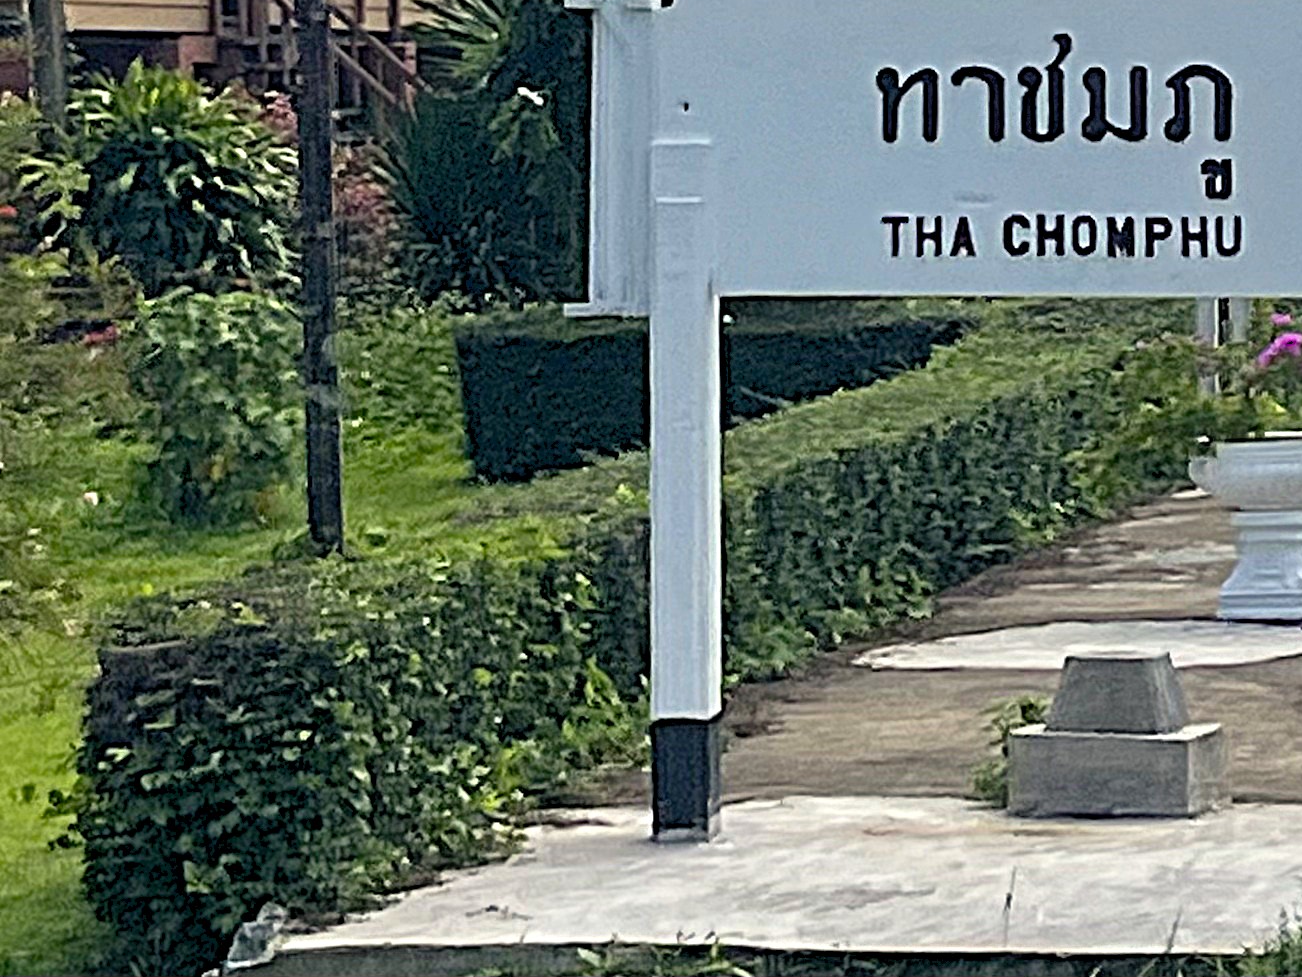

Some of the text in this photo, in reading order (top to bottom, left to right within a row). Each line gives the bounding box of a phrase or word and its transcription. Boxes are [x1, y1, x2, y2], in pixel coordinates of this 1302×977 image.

[876, 33, 1233, 201] ทาชมภู
[880, 213, 1242, 259] THA CHOMPHU
